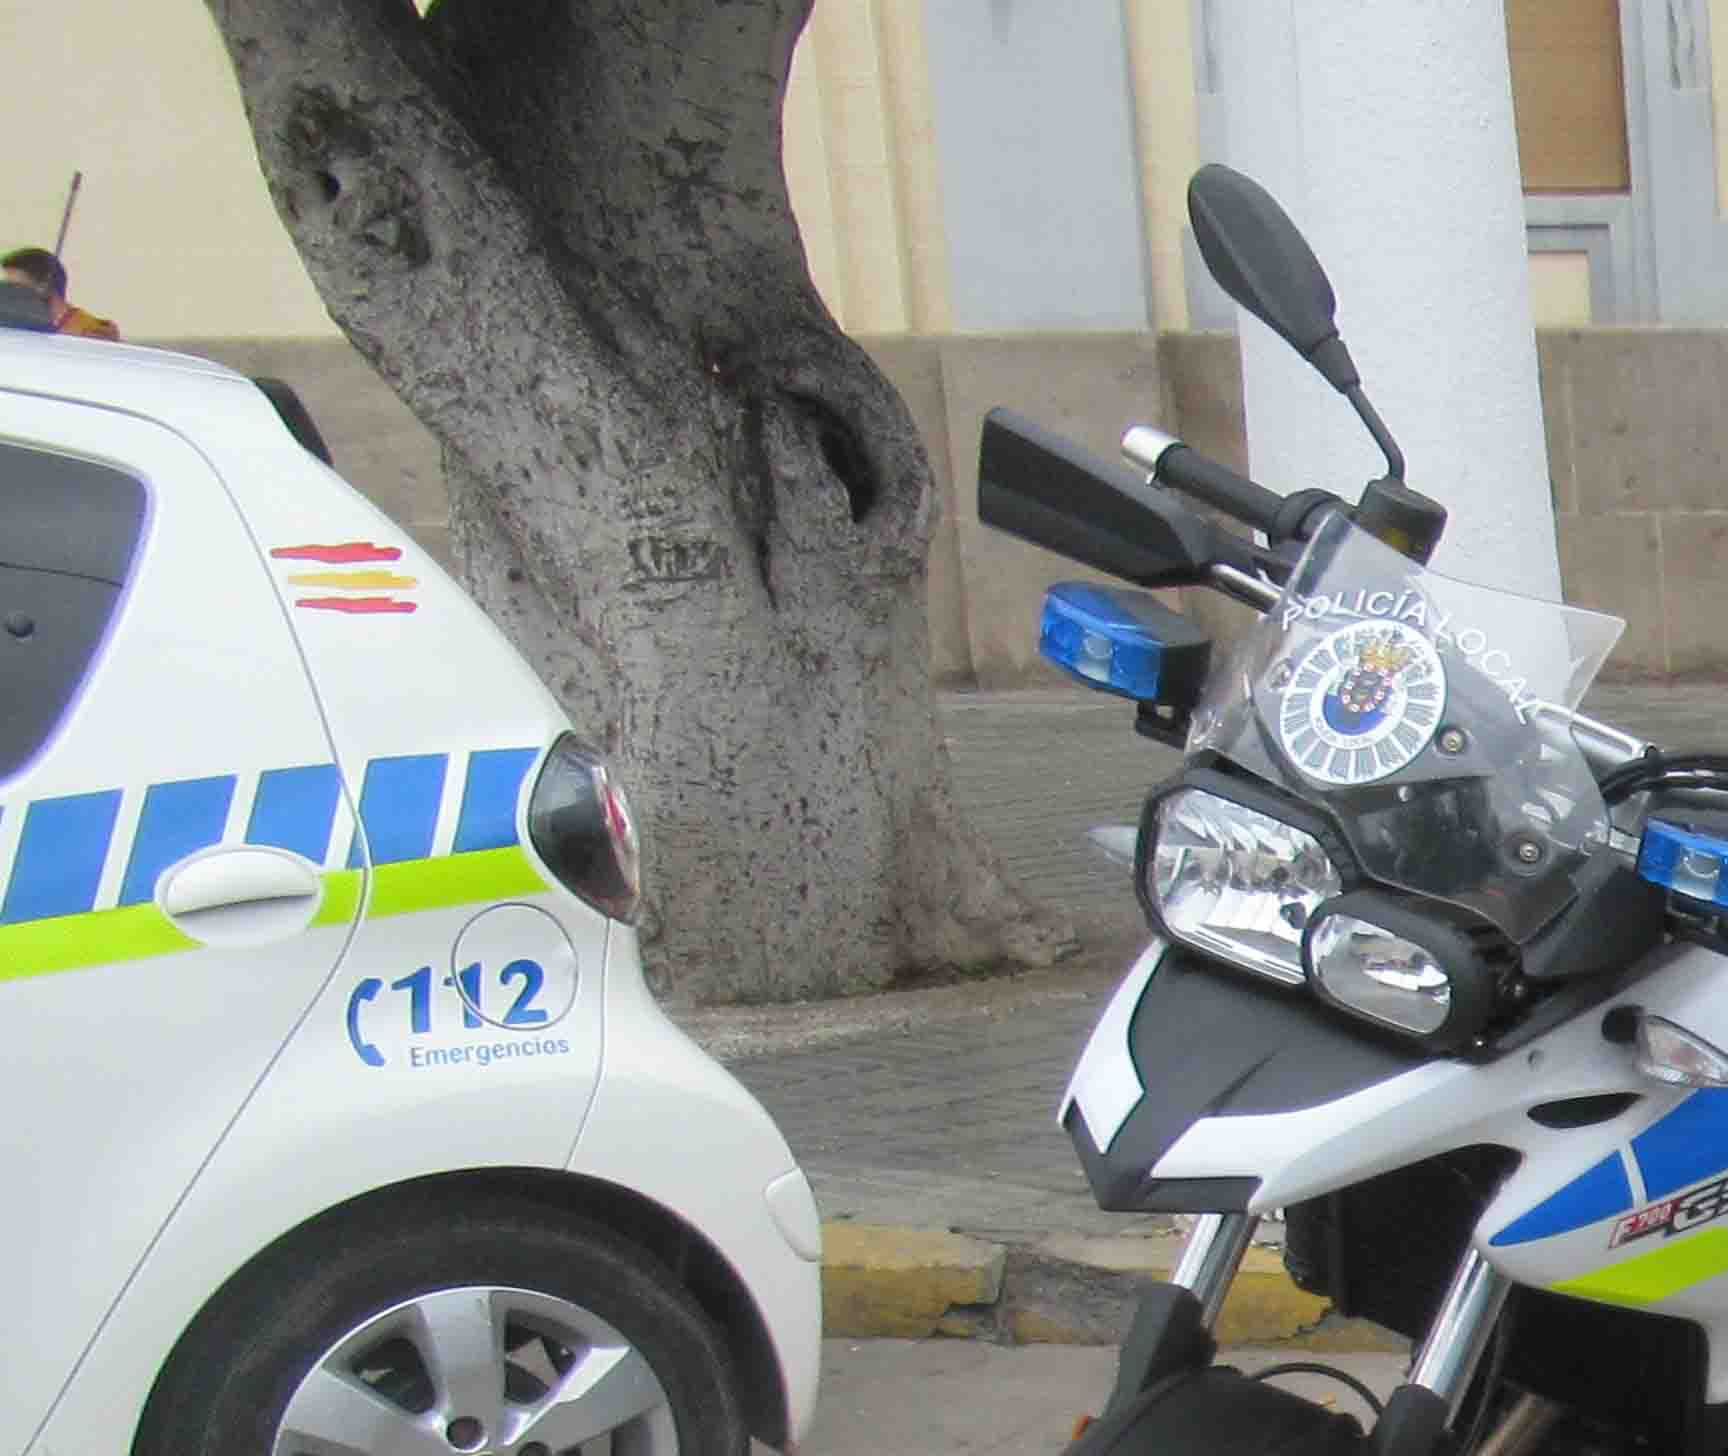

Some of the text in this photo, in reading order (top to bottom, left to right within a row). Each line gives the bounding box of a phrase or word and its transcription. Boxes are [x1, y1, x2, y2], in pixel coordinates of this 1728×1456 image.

[1281, 588, 1538, 726] POLICÍA LOCAL
[391, 959, 548, 1034] 112
[410, 1038, 570, 1068] Emergencias
